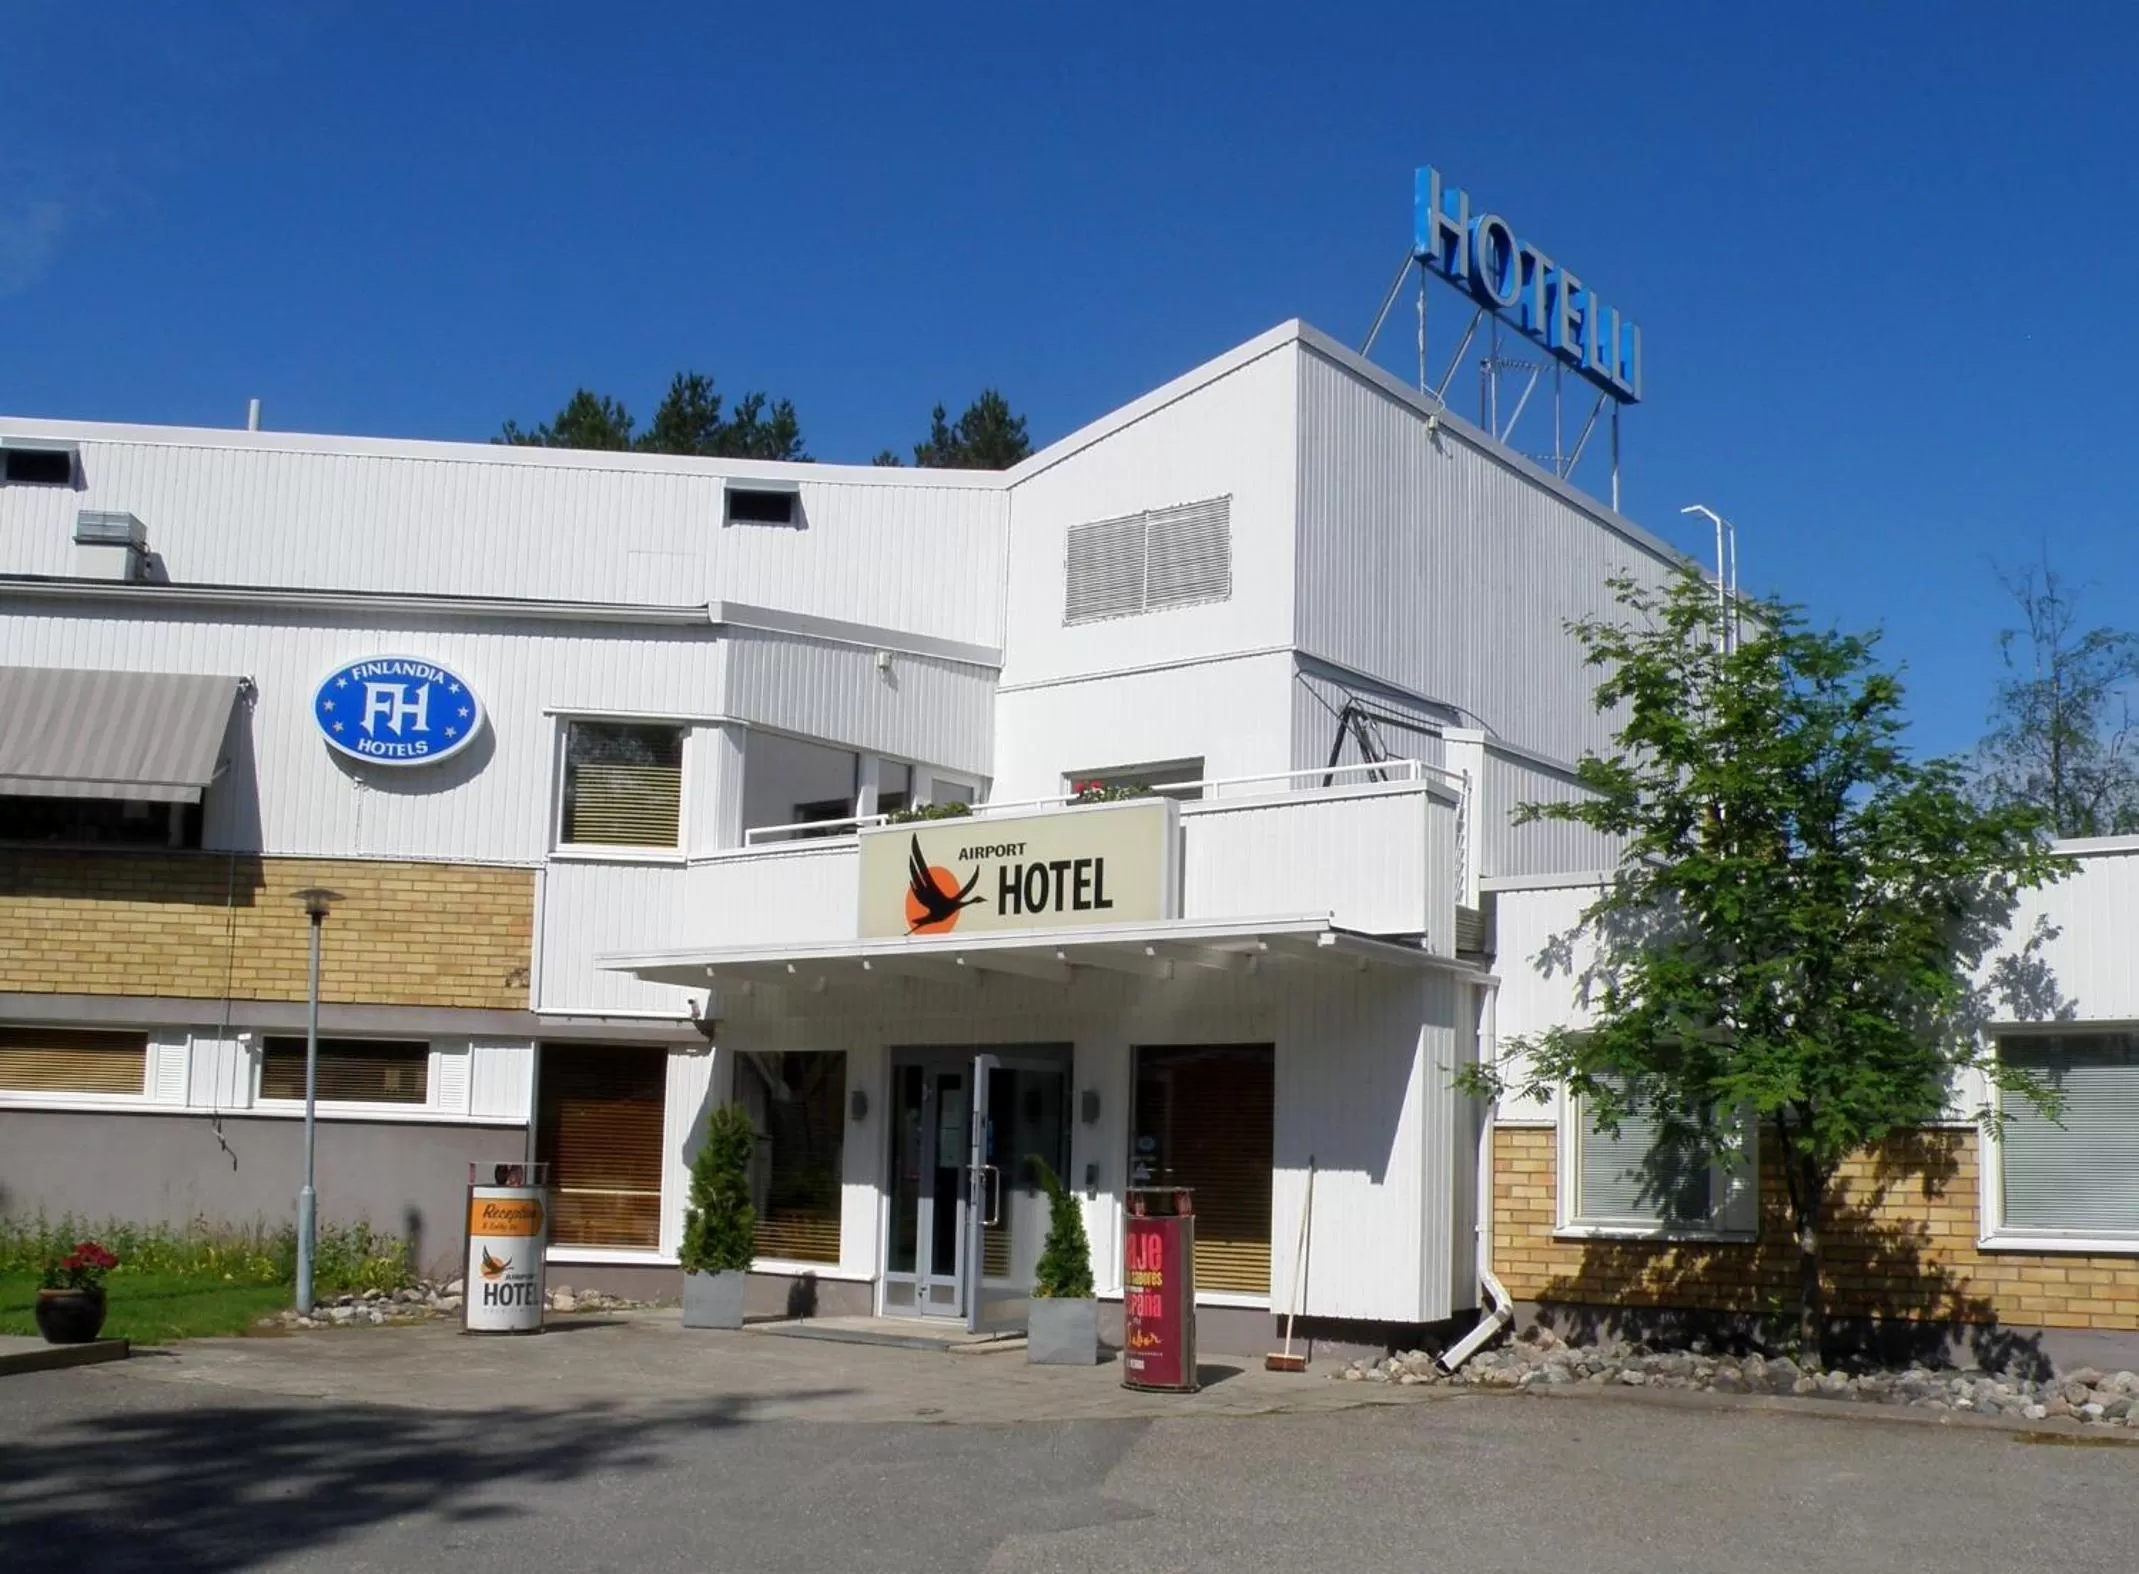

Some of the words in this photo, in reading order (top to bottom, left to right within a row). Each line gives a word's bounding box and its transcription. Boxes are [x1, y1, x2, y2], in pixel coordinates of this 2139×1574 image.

[1414, 165, 1642, 405] HOTELLI
[352, 661, 445, 685] FINLANDIA
[357, 738, 429, 757] HOTELS
[958, 842, 1027, 861] AIRPORT
[998, 857, 1113, 916] HOTEL
[483, 1282, 539, 1307] HOTEL
